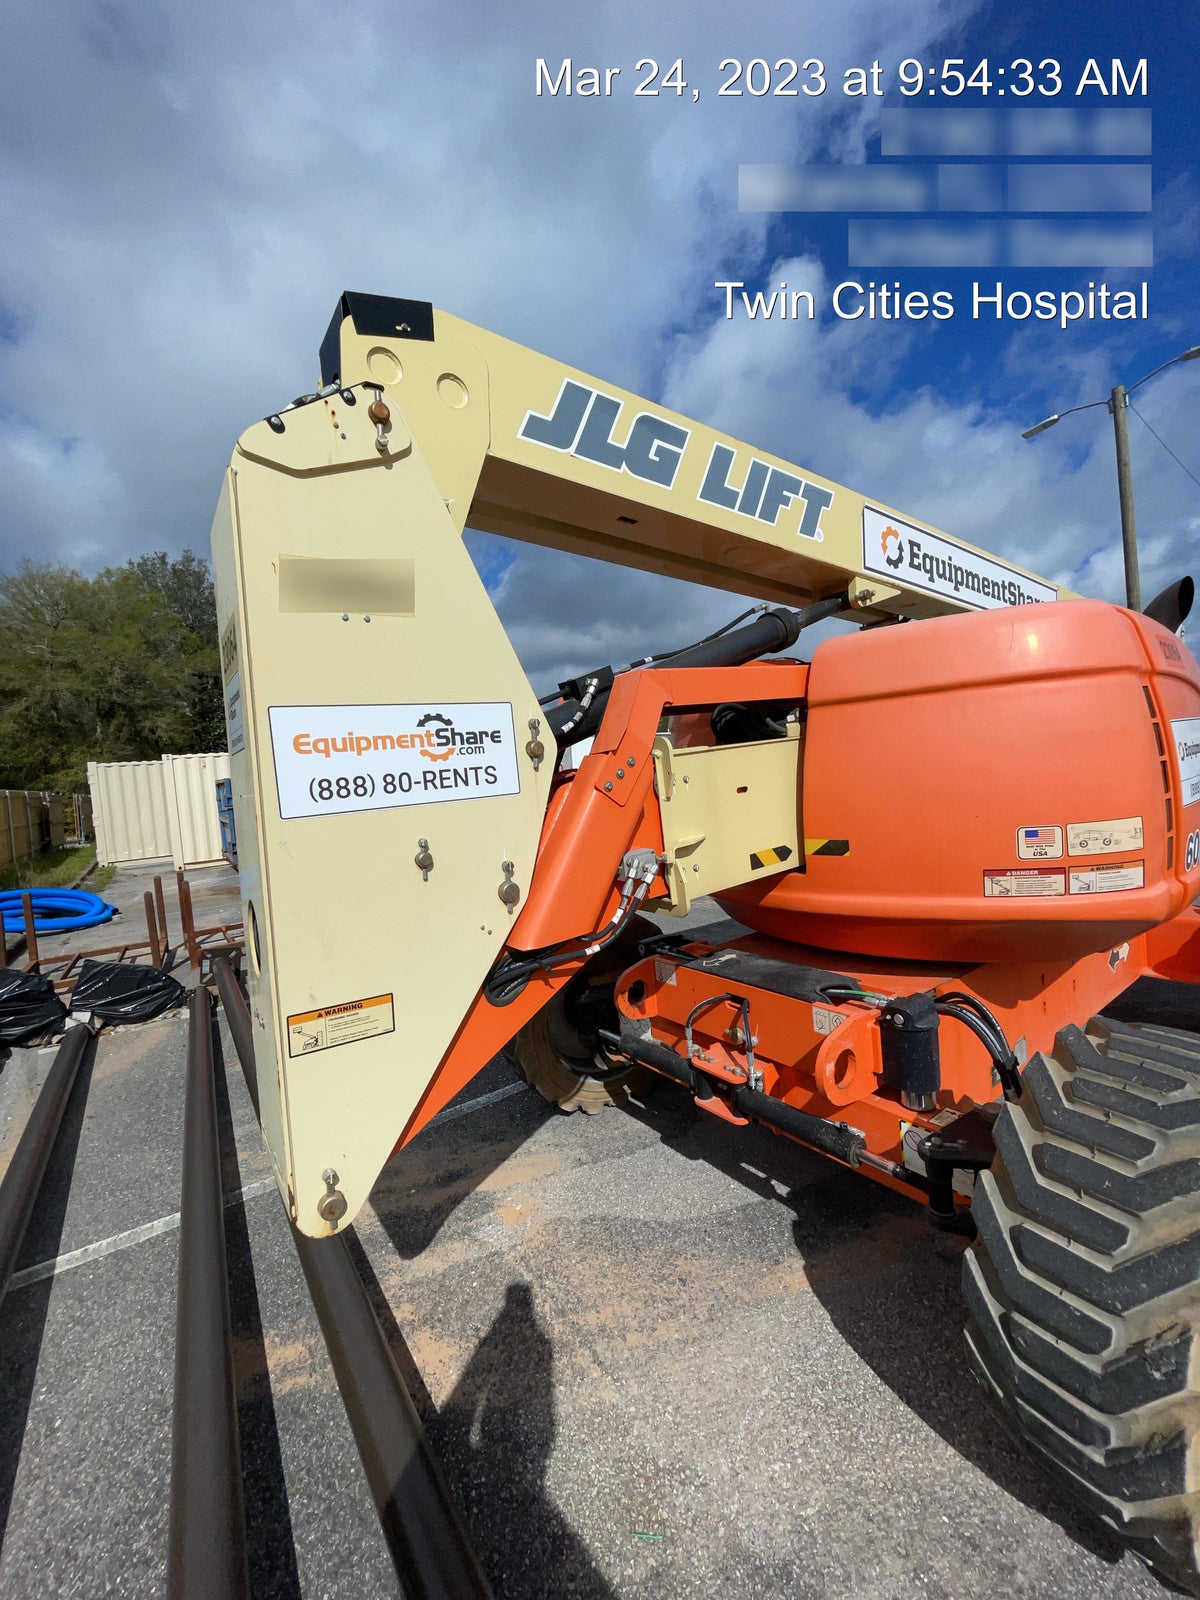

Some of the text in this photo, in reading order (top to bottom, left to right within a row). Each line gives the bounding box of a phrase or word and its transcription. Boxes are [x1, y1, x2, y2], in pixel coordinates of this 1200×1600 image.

[516, 377, 834, 540] JLG LIFT
[292, 727, 502, 758] EquipmentShare
[456, 745, 486, 756] .com
[309, 765, 498, 803] (888) 80-RENTS
[1095, 859, 1125, 872] WARNING
[324, 1002, 363, 1017] WARNING
